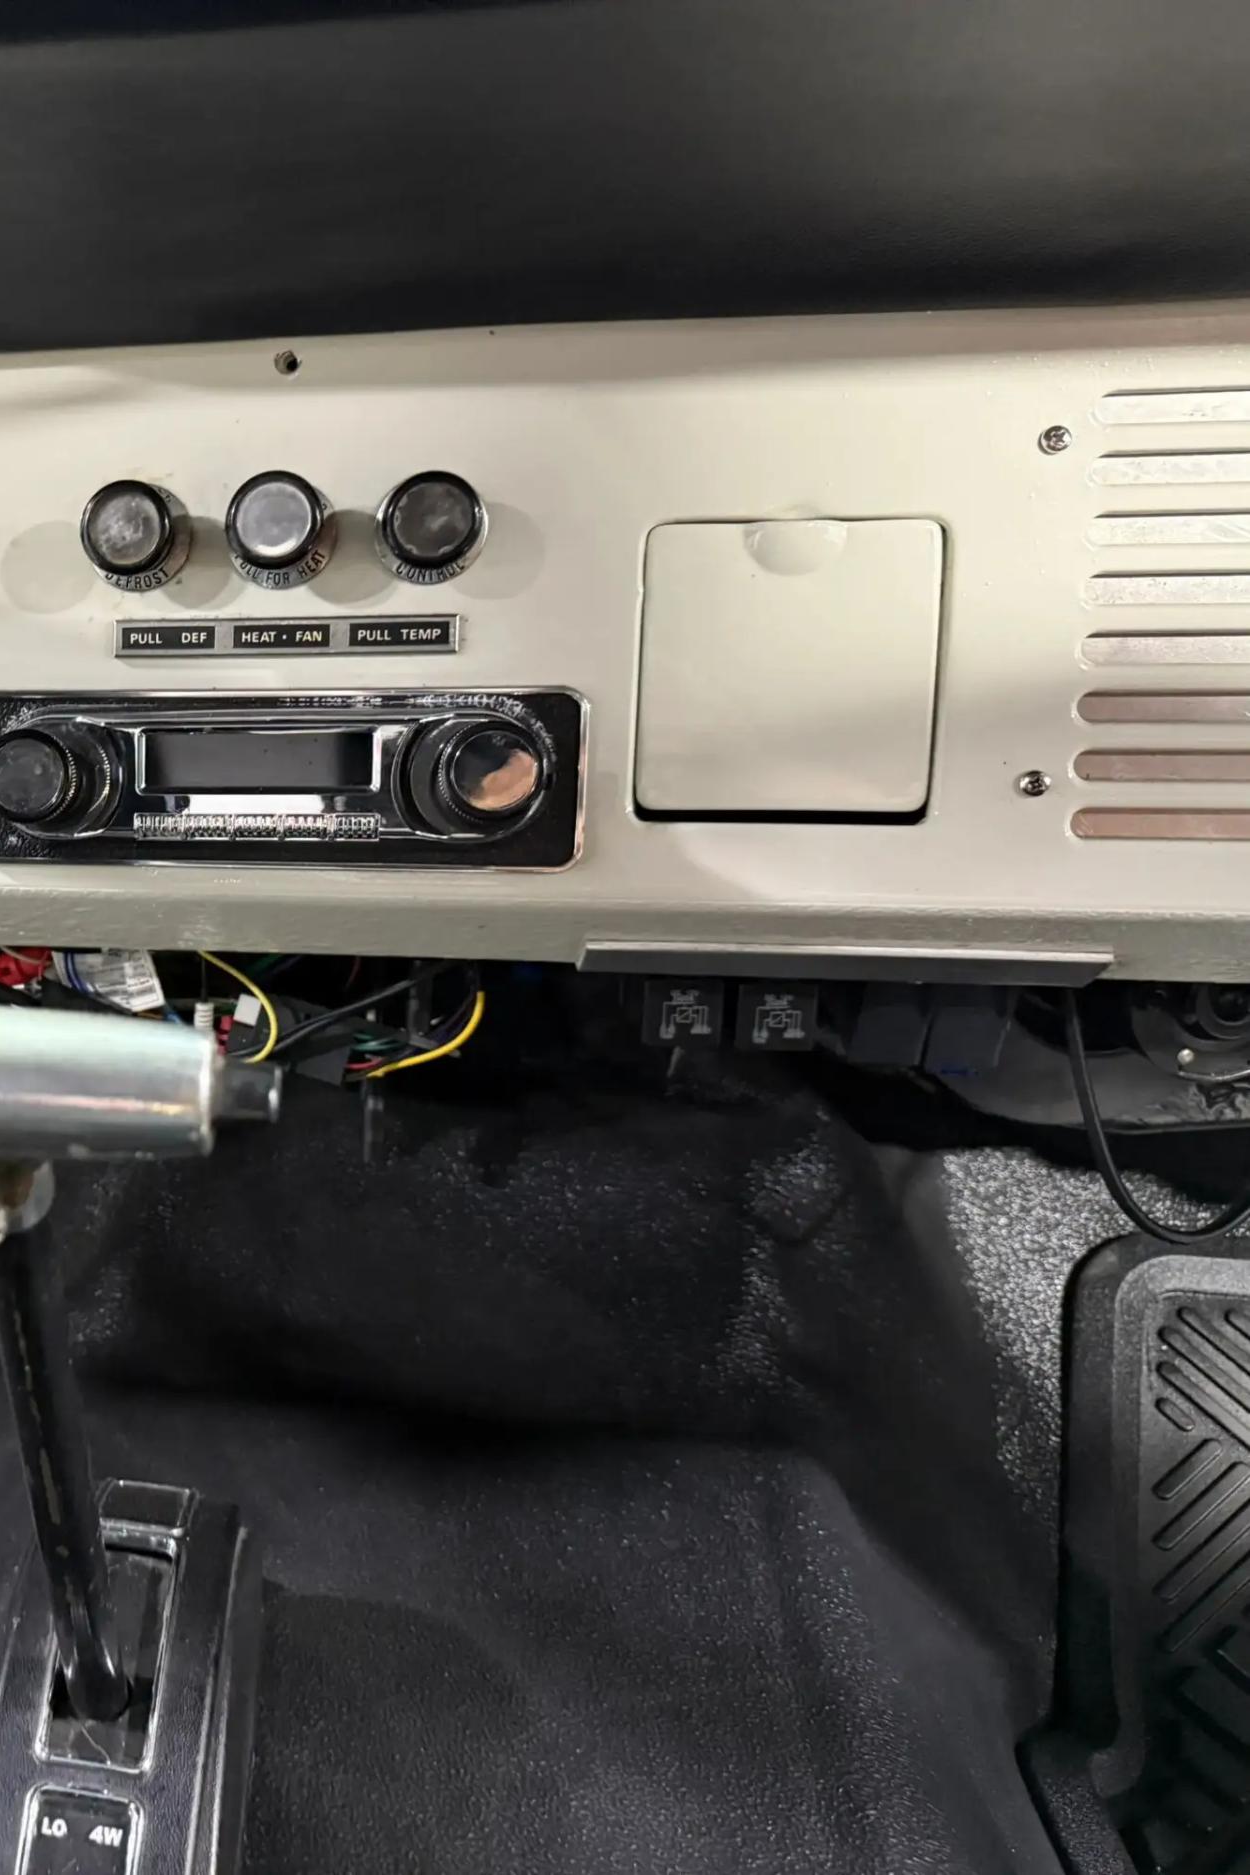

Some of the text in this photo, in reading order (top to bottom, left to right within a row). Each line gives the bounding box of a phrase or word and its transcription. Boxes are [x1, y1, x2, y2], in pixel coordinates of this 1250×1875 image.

[266, 572, 291, 586] FOR
[297, 549, 326, 579] HEAT
[130, 631, 207, 645] PULL DEF
[241, 630, 323, 643] HEAT FAN
[357, 628, 442, 641] PULL TEMP
[40, 1816, 124, 1847] LO 4W
